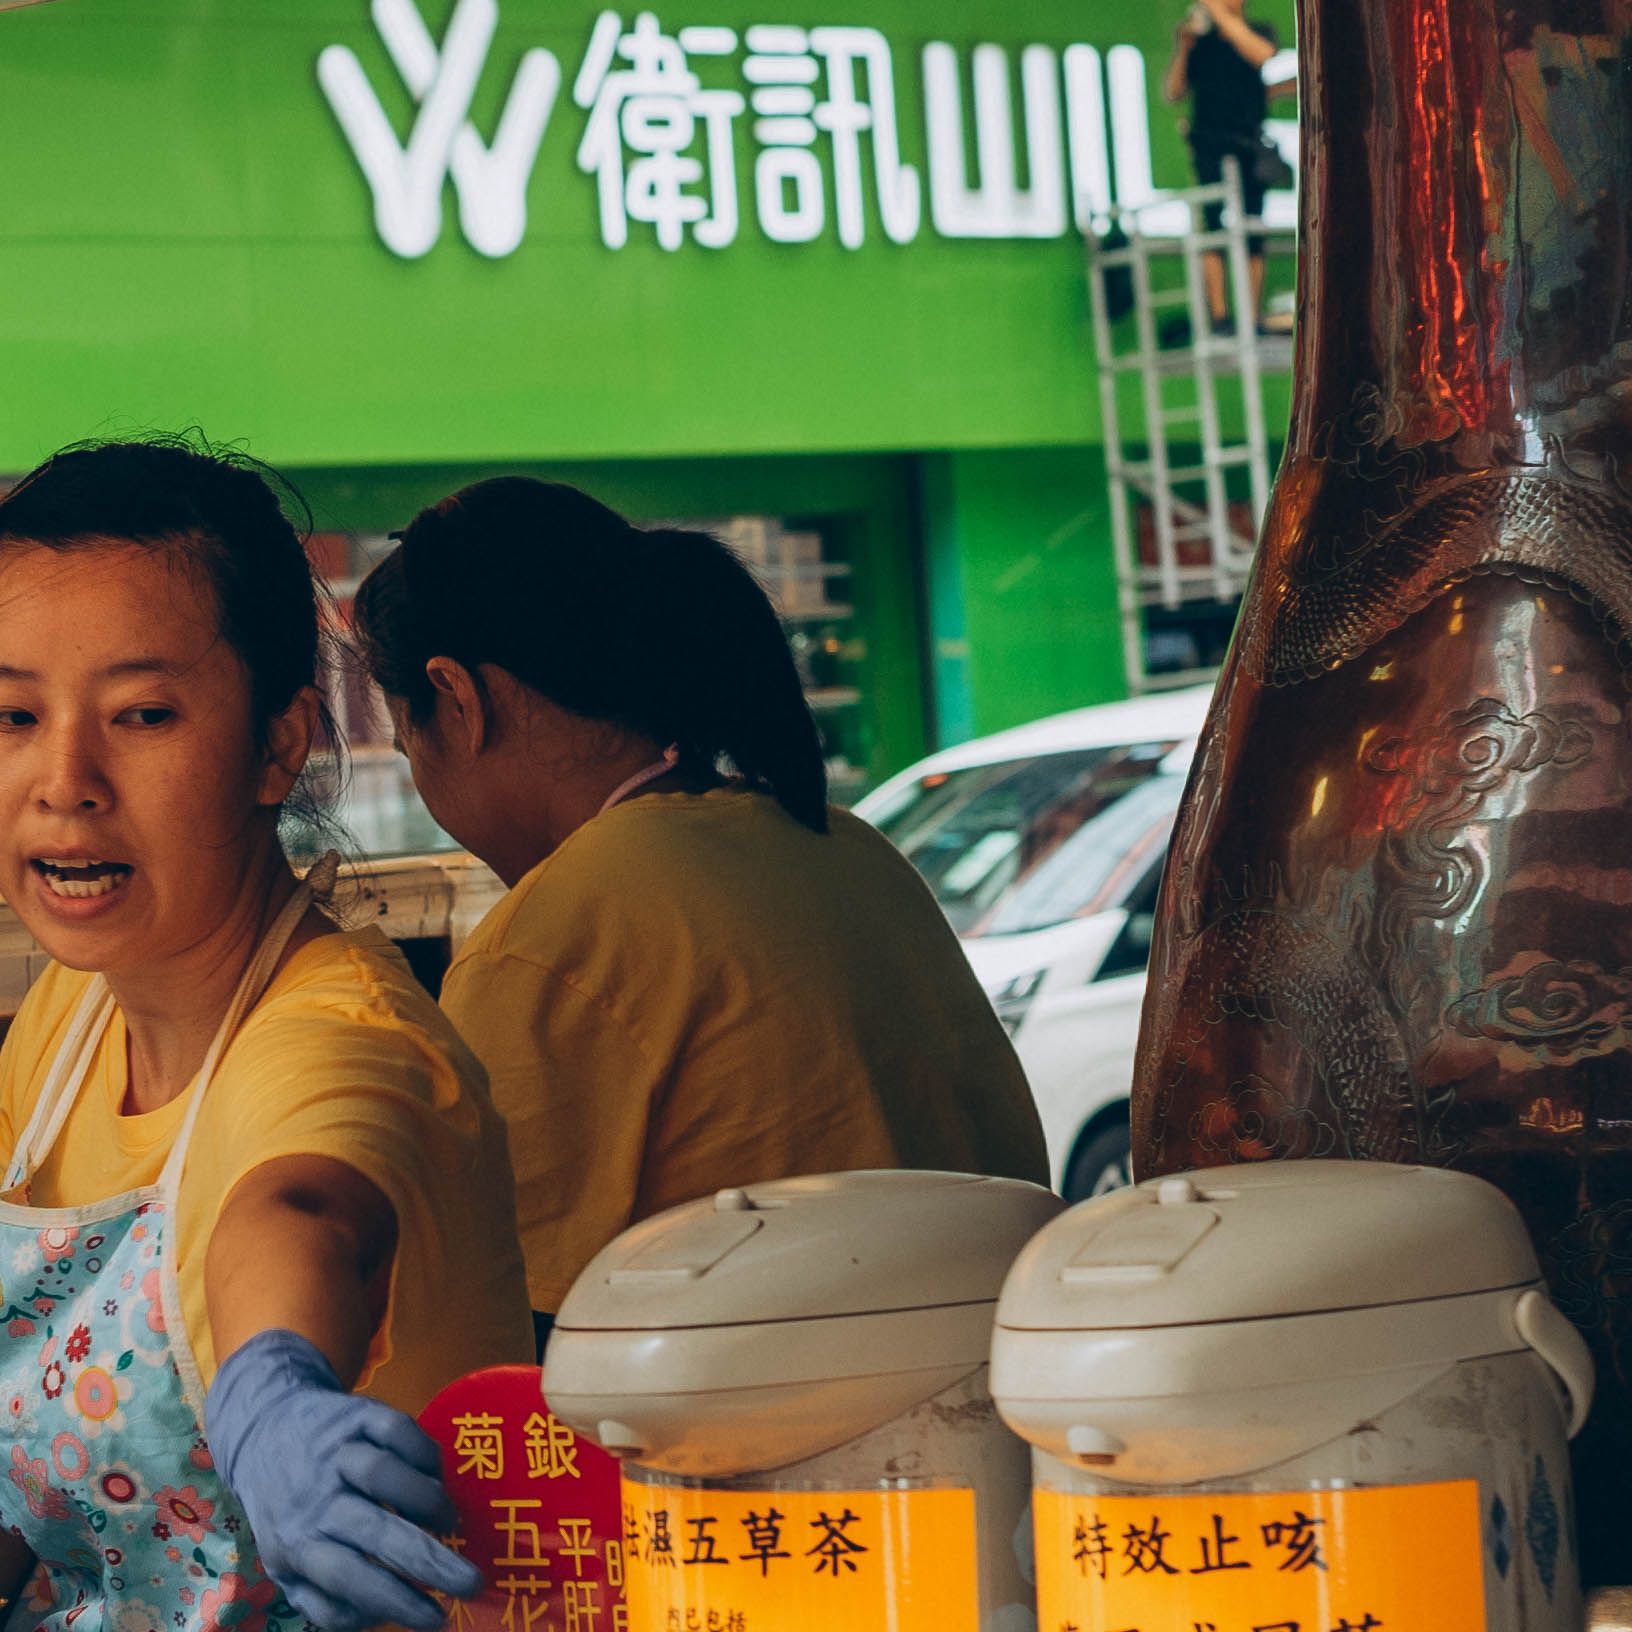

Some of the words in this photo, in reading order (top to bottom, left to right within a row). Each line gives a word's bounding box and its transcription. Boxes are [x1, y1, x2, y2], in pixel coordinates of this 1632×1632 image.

[574, 10, 922, 252] 衛訊
[1073, 1511, 1329, 1580] 特效止咳
